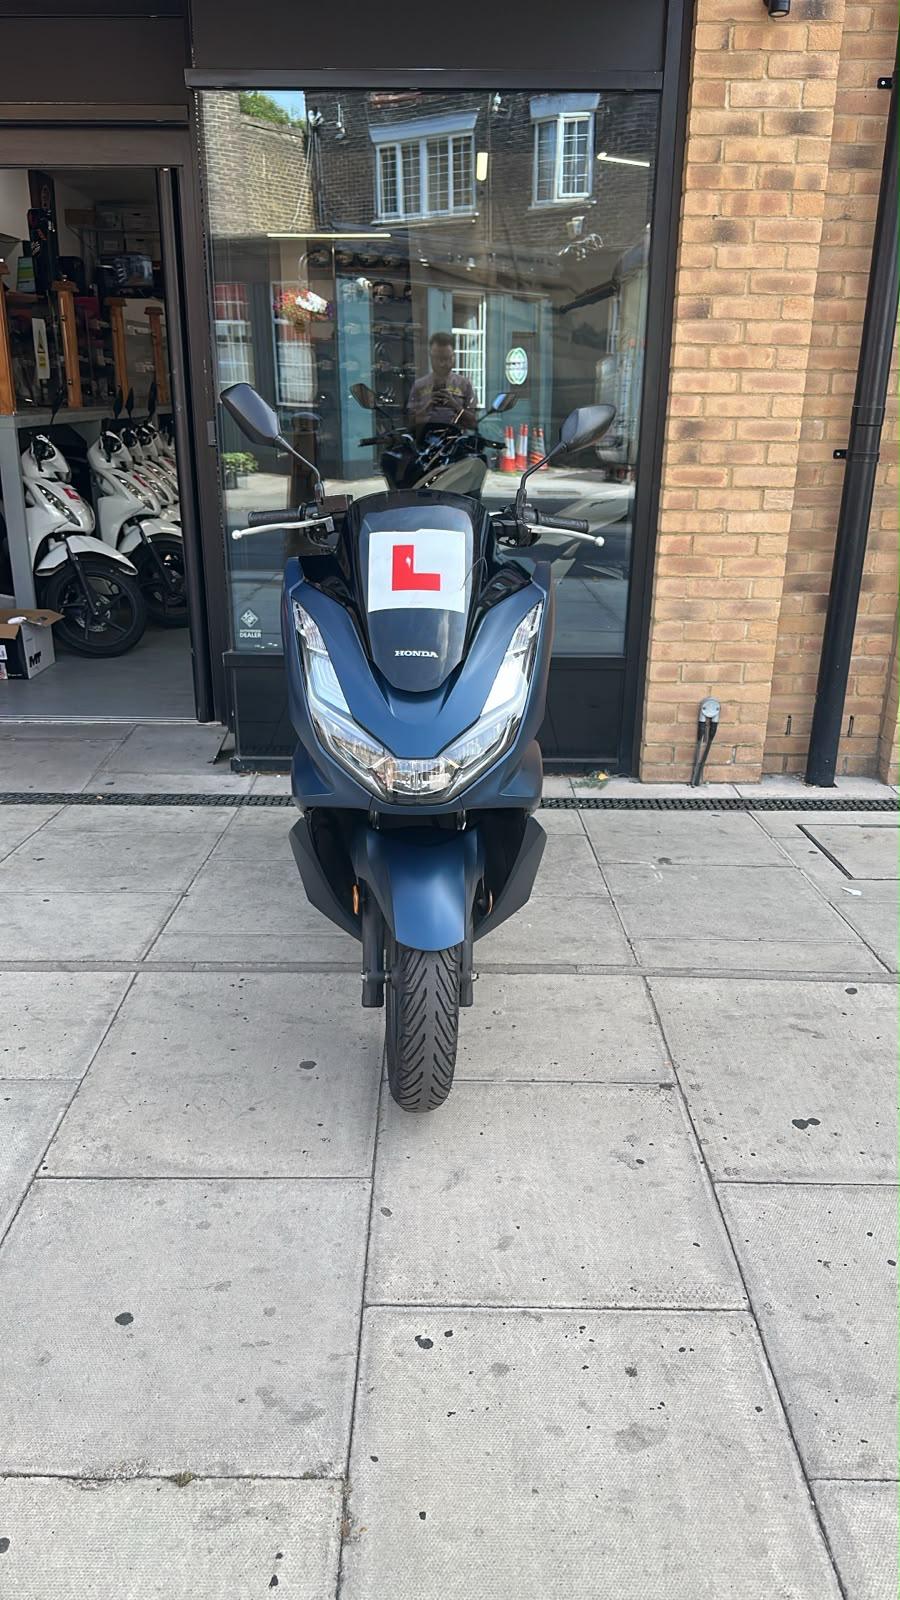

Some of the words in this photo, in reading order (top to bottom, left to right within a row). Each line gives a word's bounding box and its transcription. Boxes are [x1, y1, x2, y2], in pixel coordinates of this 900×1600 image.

[391, 544, 441, 592] L
[29, 650, 42, 668] MT
[394, 650, 439, 659] HONDA
